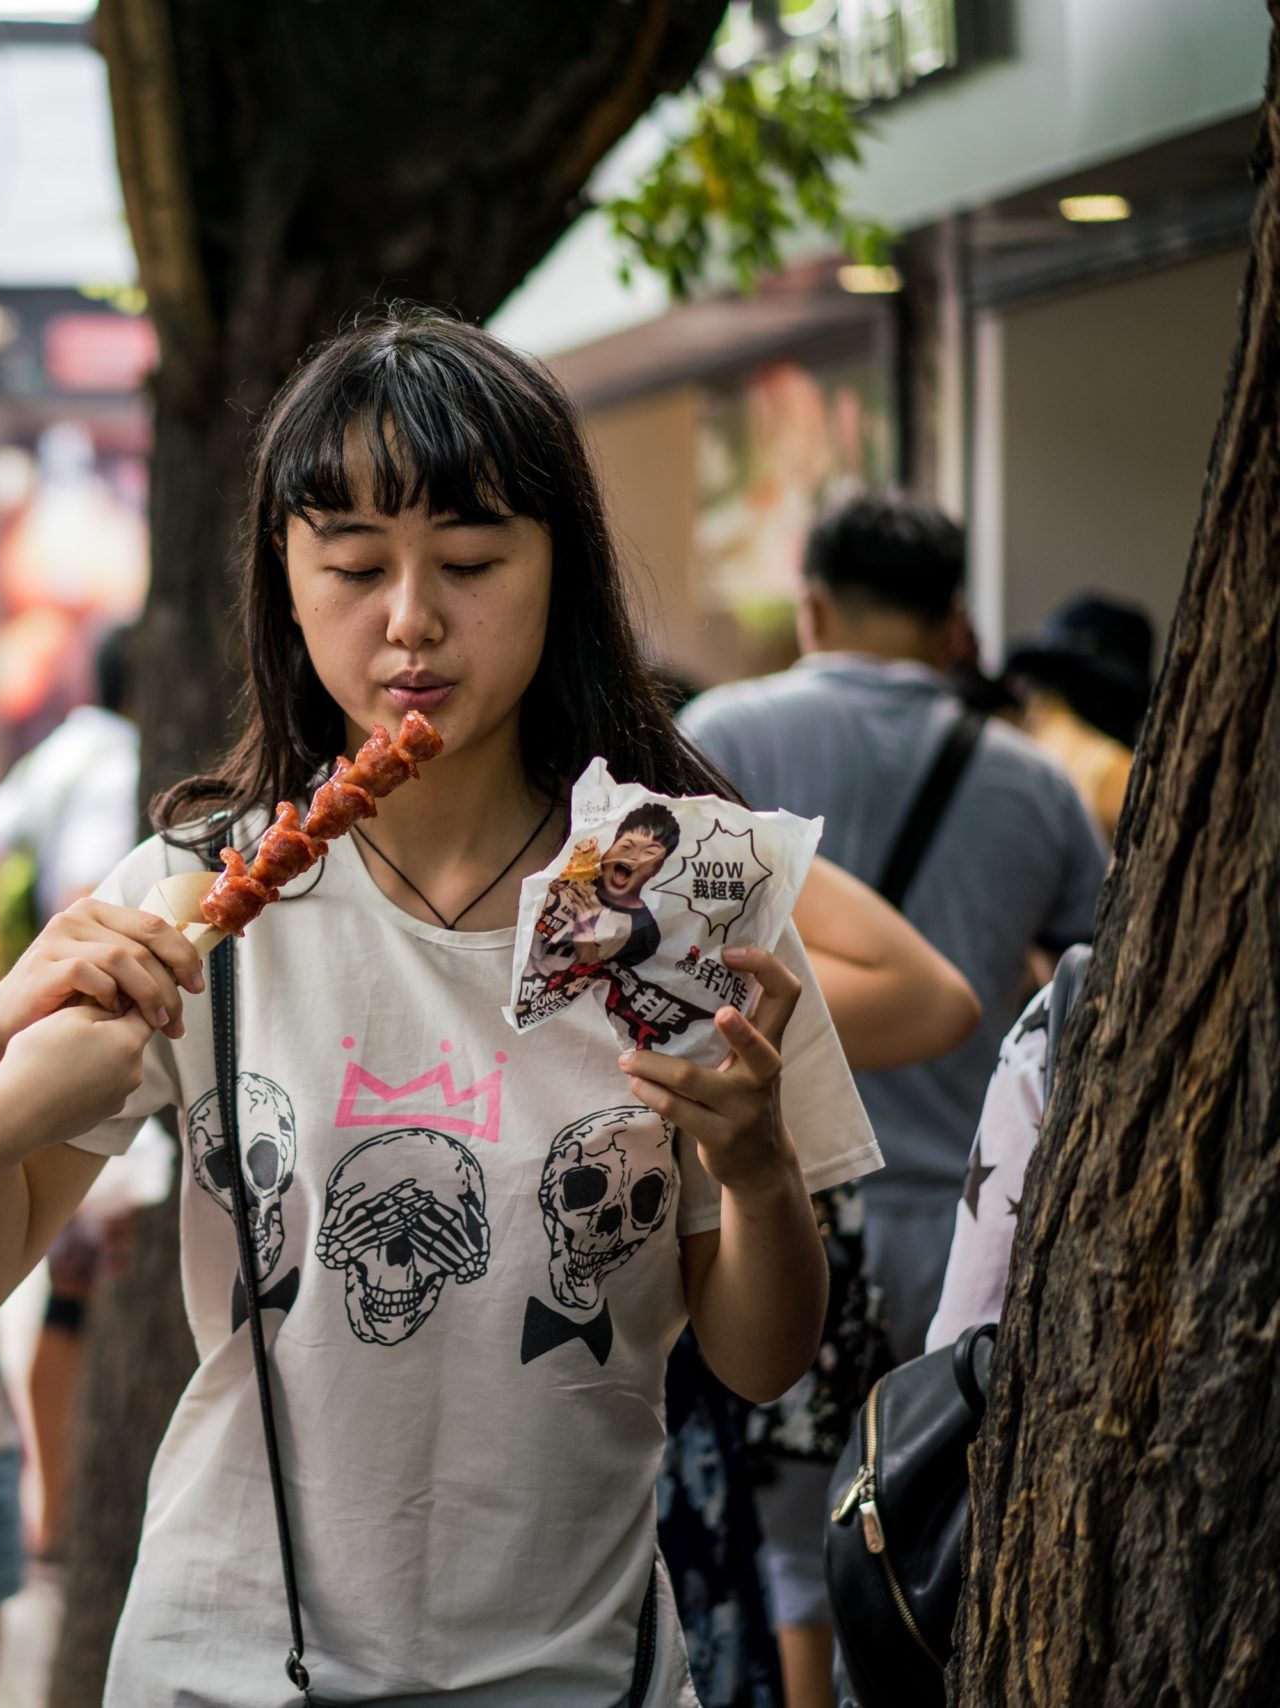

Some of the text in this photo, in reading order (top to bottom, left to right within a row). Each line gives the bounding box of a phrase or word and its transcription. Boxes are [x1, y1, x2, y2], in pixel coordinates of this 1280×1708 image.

[691, 861, 743, 878] WOW
[693, 879, 745, 901] 我超爱
[520, 997, 571, 1027] CHICKEN
